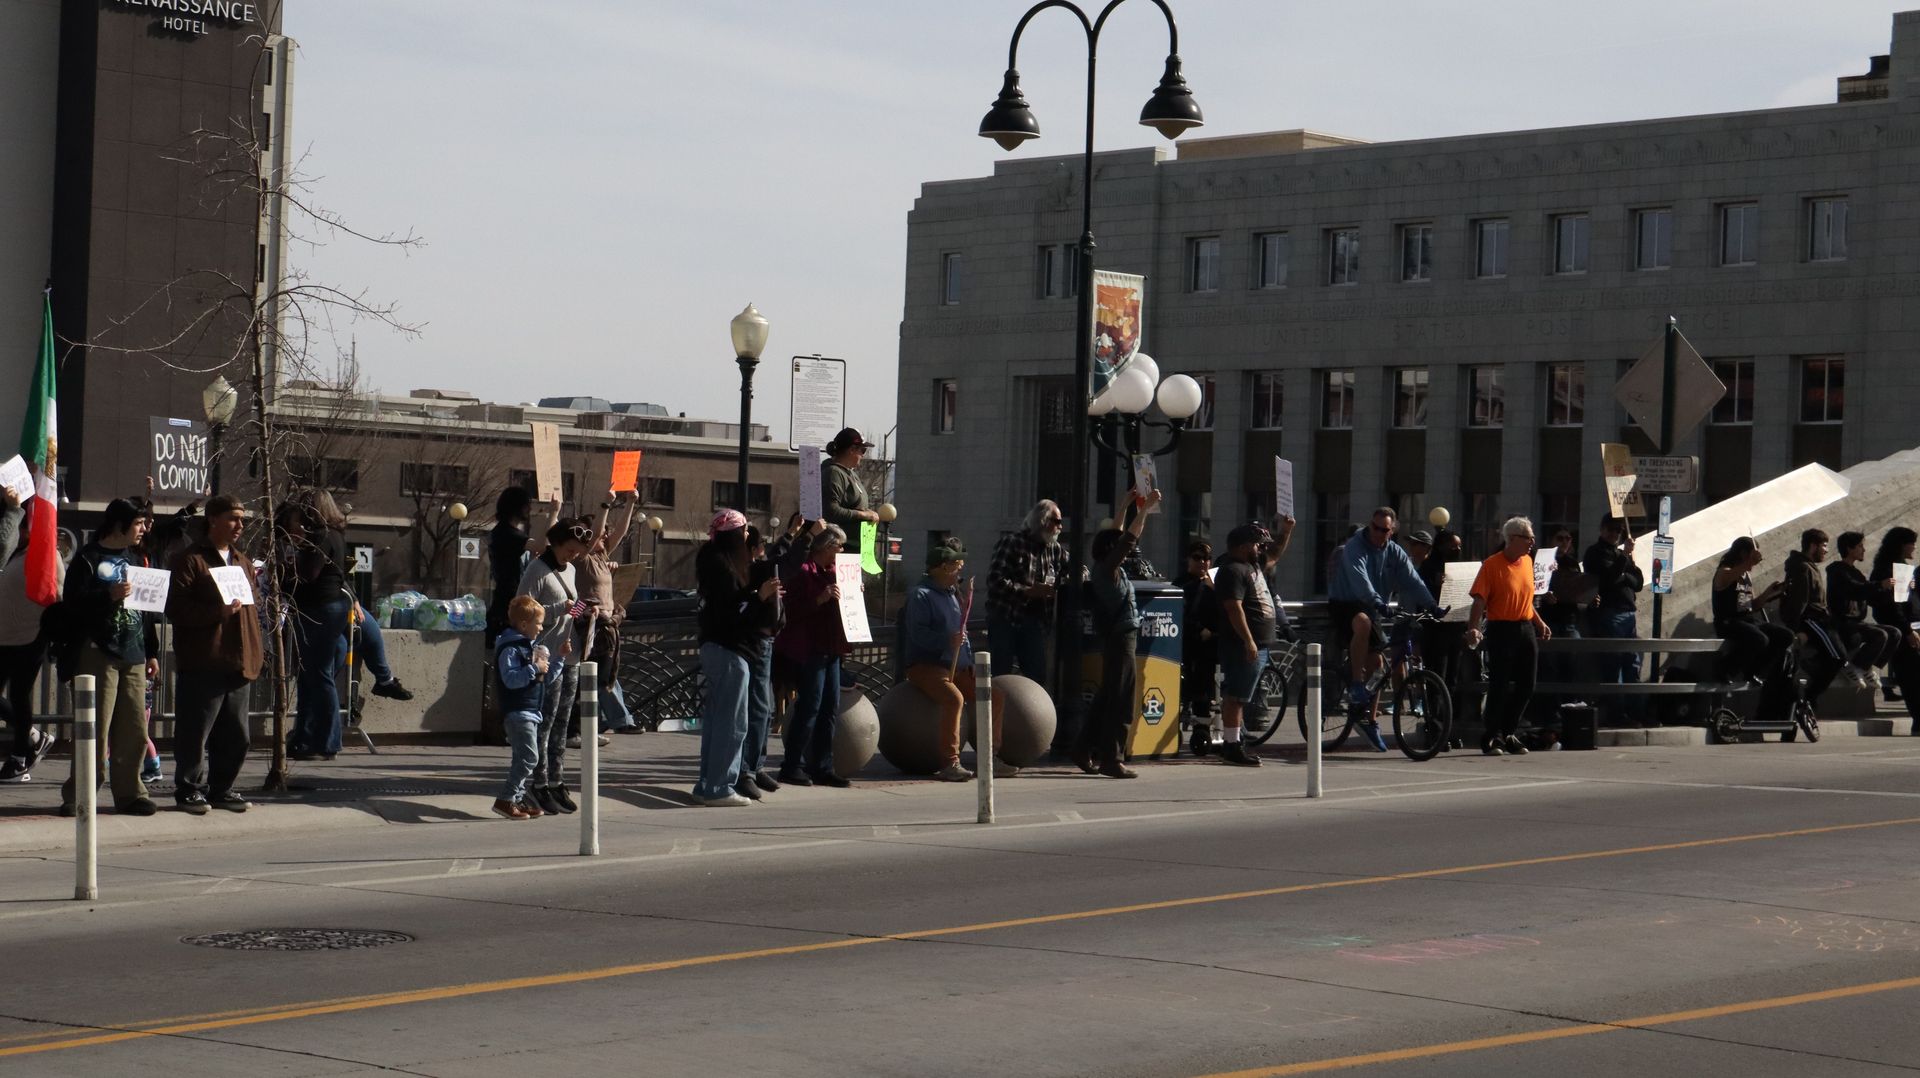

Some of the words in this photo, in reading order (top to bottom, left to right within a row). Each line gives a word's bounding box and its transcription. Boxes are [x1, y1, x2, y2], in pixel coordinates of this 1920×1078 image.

[163, 16, 209, 35] HOTEL
[1392, 320, 1467, 342] STATES
[1526, 317, 1583, 337] POST
[1645, 311, 1732, 334] OFICE
[155, 433, 175, 461] DO
[180, 433, 208, 467] NOT
[159, 464, 208, 494] COMPLY
[1612, 491, 1639, 505] MURDER
[838, 562, 860, 582] STOP
[134, 587, 159, 603] ICE
[1141, 623, 1179, 637] RENO
[1147, 700, 1160, 715] R
